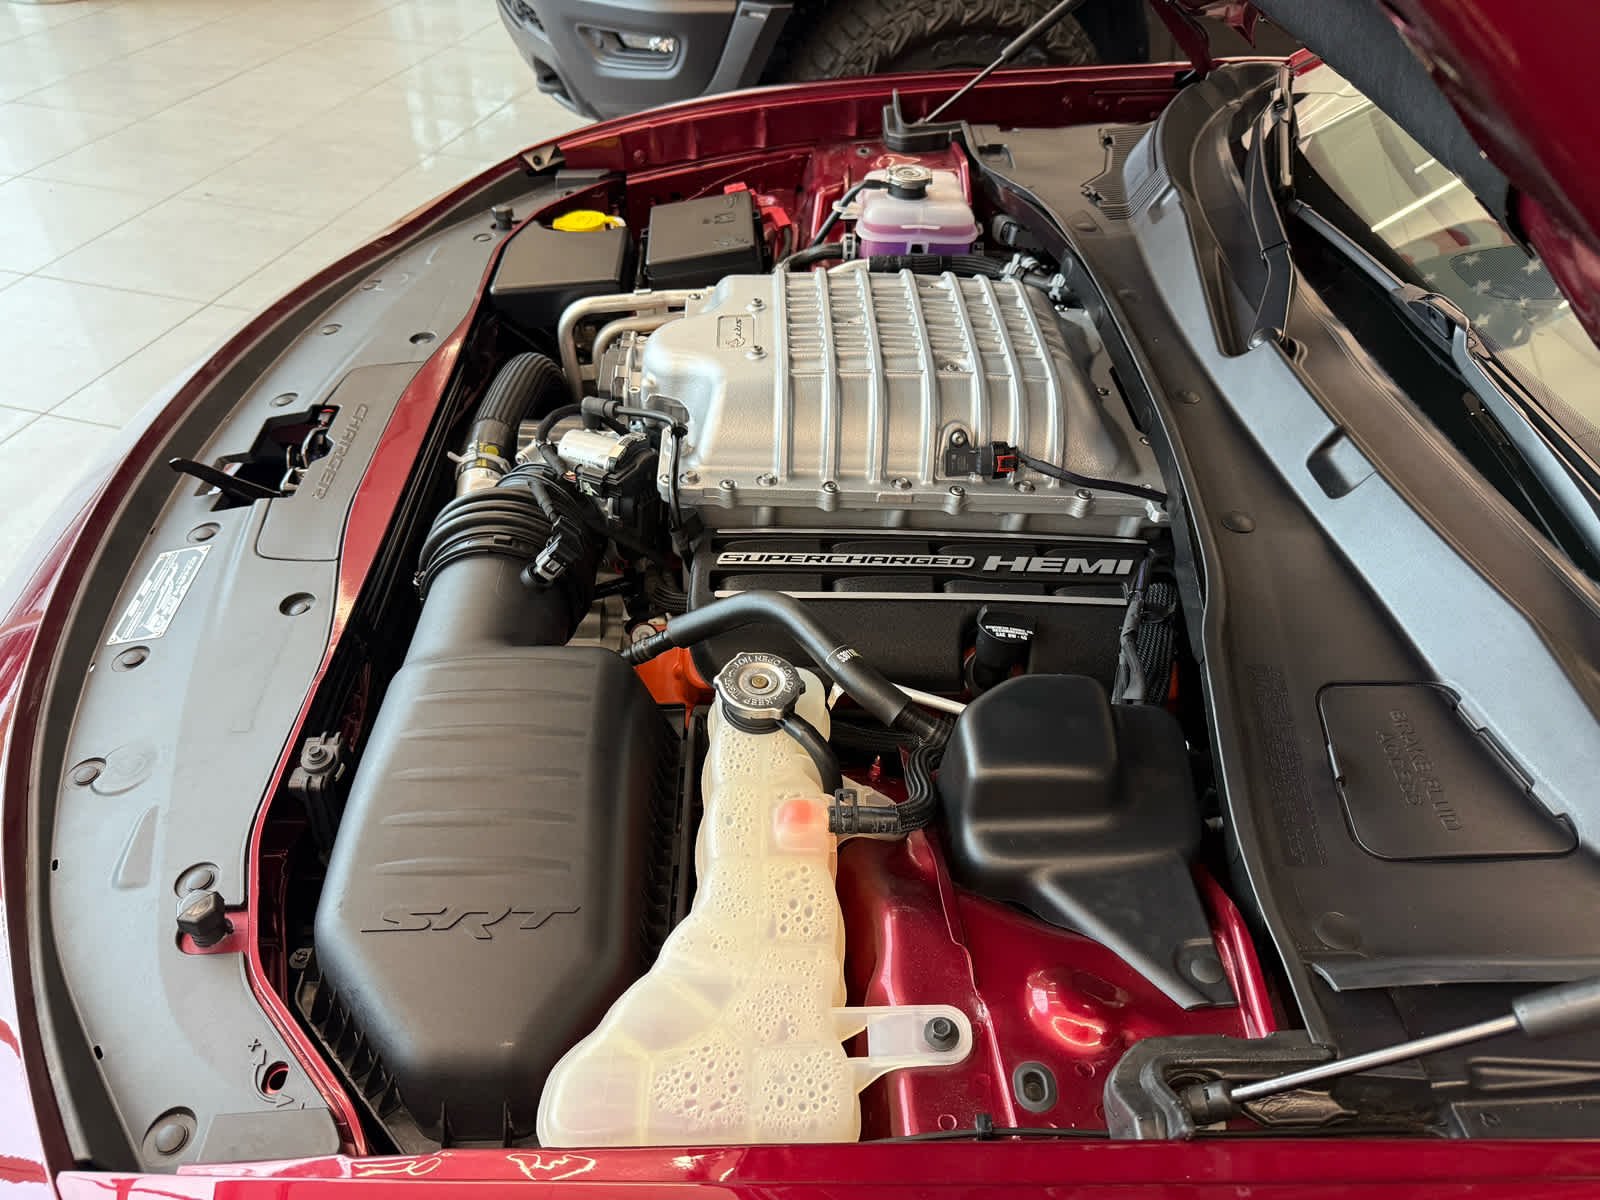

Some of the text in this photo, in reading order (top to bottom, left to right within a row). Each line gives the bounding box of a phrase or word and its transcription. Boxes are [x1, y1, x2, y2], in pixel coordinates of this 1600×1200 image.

[311, 403, 369, 500] CHARGER
[720, 553, 1134, 575] SUPERCHARGED HEMI
[754, 655, 781, 666] OPEN
[743, 698, 774, 706] KEEP
[359, 903, 582, 940] SRT
